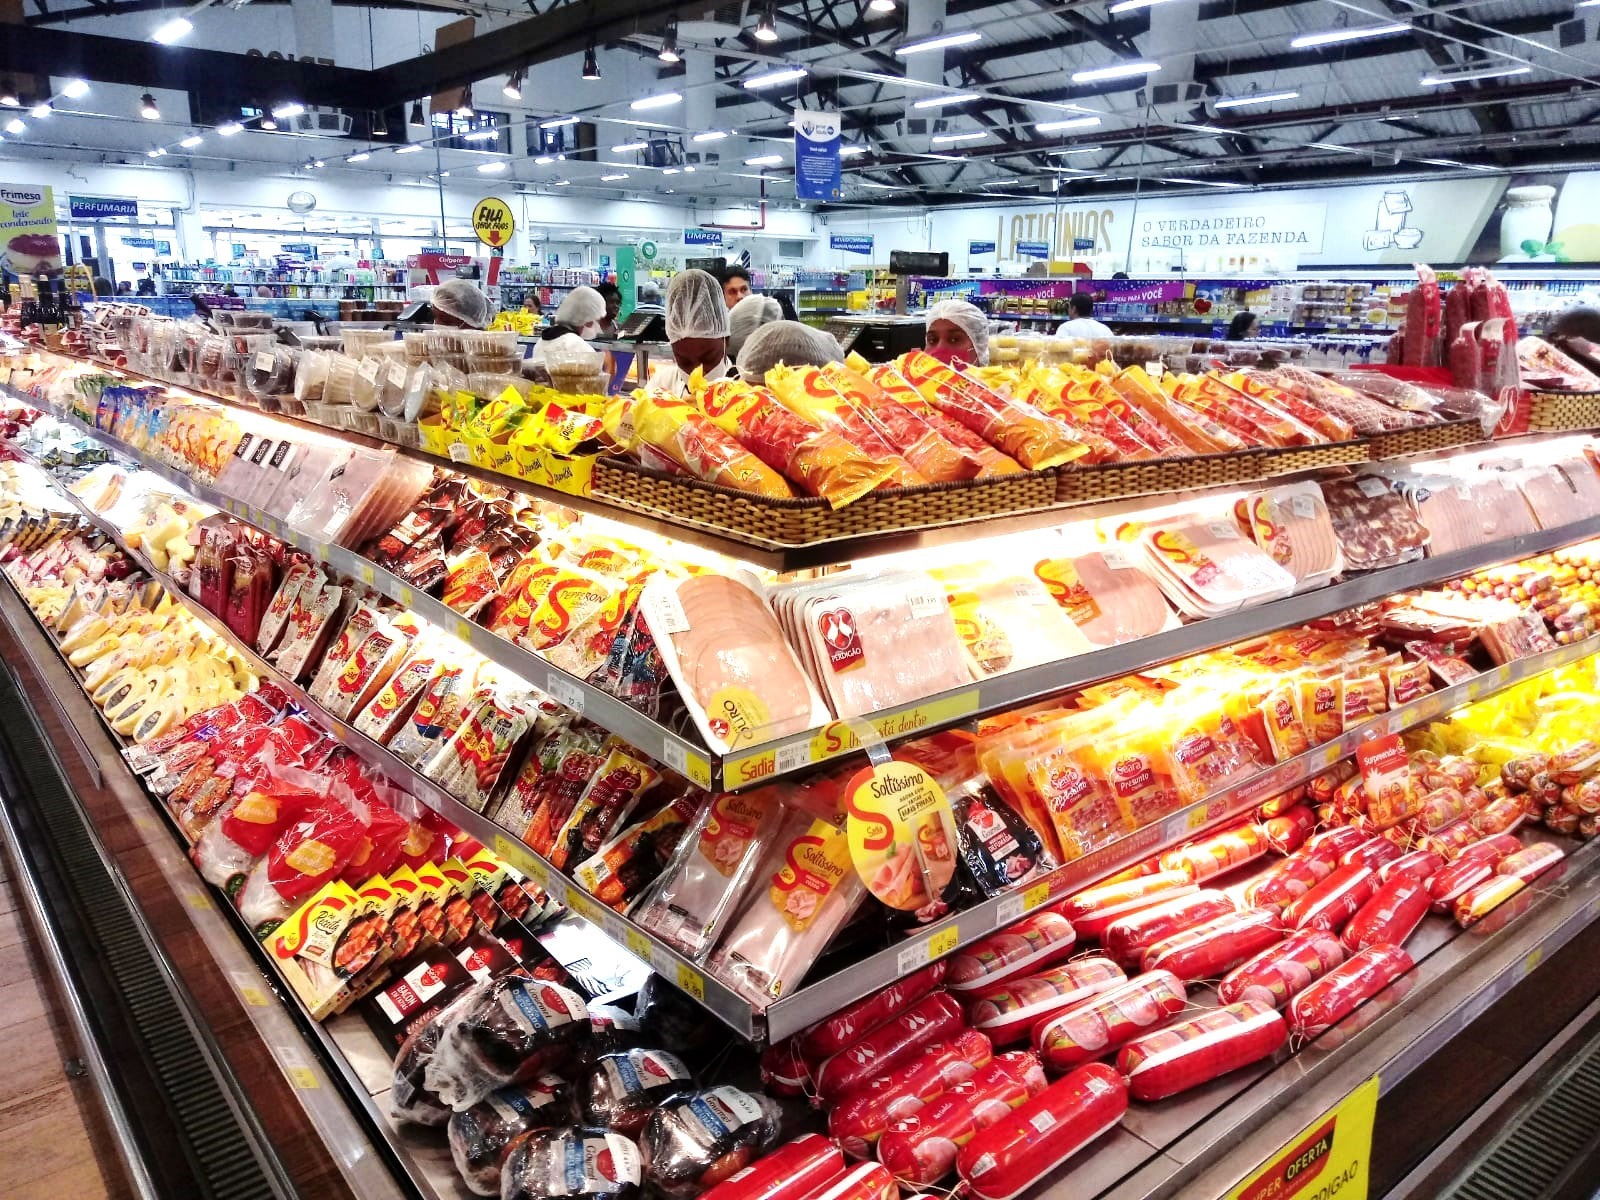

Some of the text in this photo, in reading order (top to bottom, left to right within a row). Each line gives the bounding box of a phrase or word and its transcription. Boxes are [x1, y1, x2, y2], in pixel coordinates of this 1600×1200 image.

[1, 189, 41, 201] Frimesa
[72, 201, 137, 214] PERFUMARIA
[479, 206, 504, 223] FILA
[1143, 216, 1266, 232] O VERDADEIRO
[687, 232, 721, 241] LIMPEZA
[1142, 231, 1310, 248] SABOR DA FAZENDA
[1036, 288, 1055, 298] VOCÊ
[1142, 287, 1162, 300] VOCÊ
[831, 648, 862, 662] PERDIGÃO
[723, 700, 754, 740] OURO
[898, 710, 926, 732] dentro
[740, 752, 776, 782] Sadia
[1117, 761, 1142, 775] Seara
[871, 773, 924, 799] Soltíssimo
[1120, 773, 1149, 791] Presunto
[397, 984, 417, 1007] BACON
[529, 988, 552, 1019] Gourmet
[706, 1096, 732, 1124] Gourmet
[586, 1145, 598, 1181] Gourmet
[1287, 1138, 1328, 1181] OFERTA
